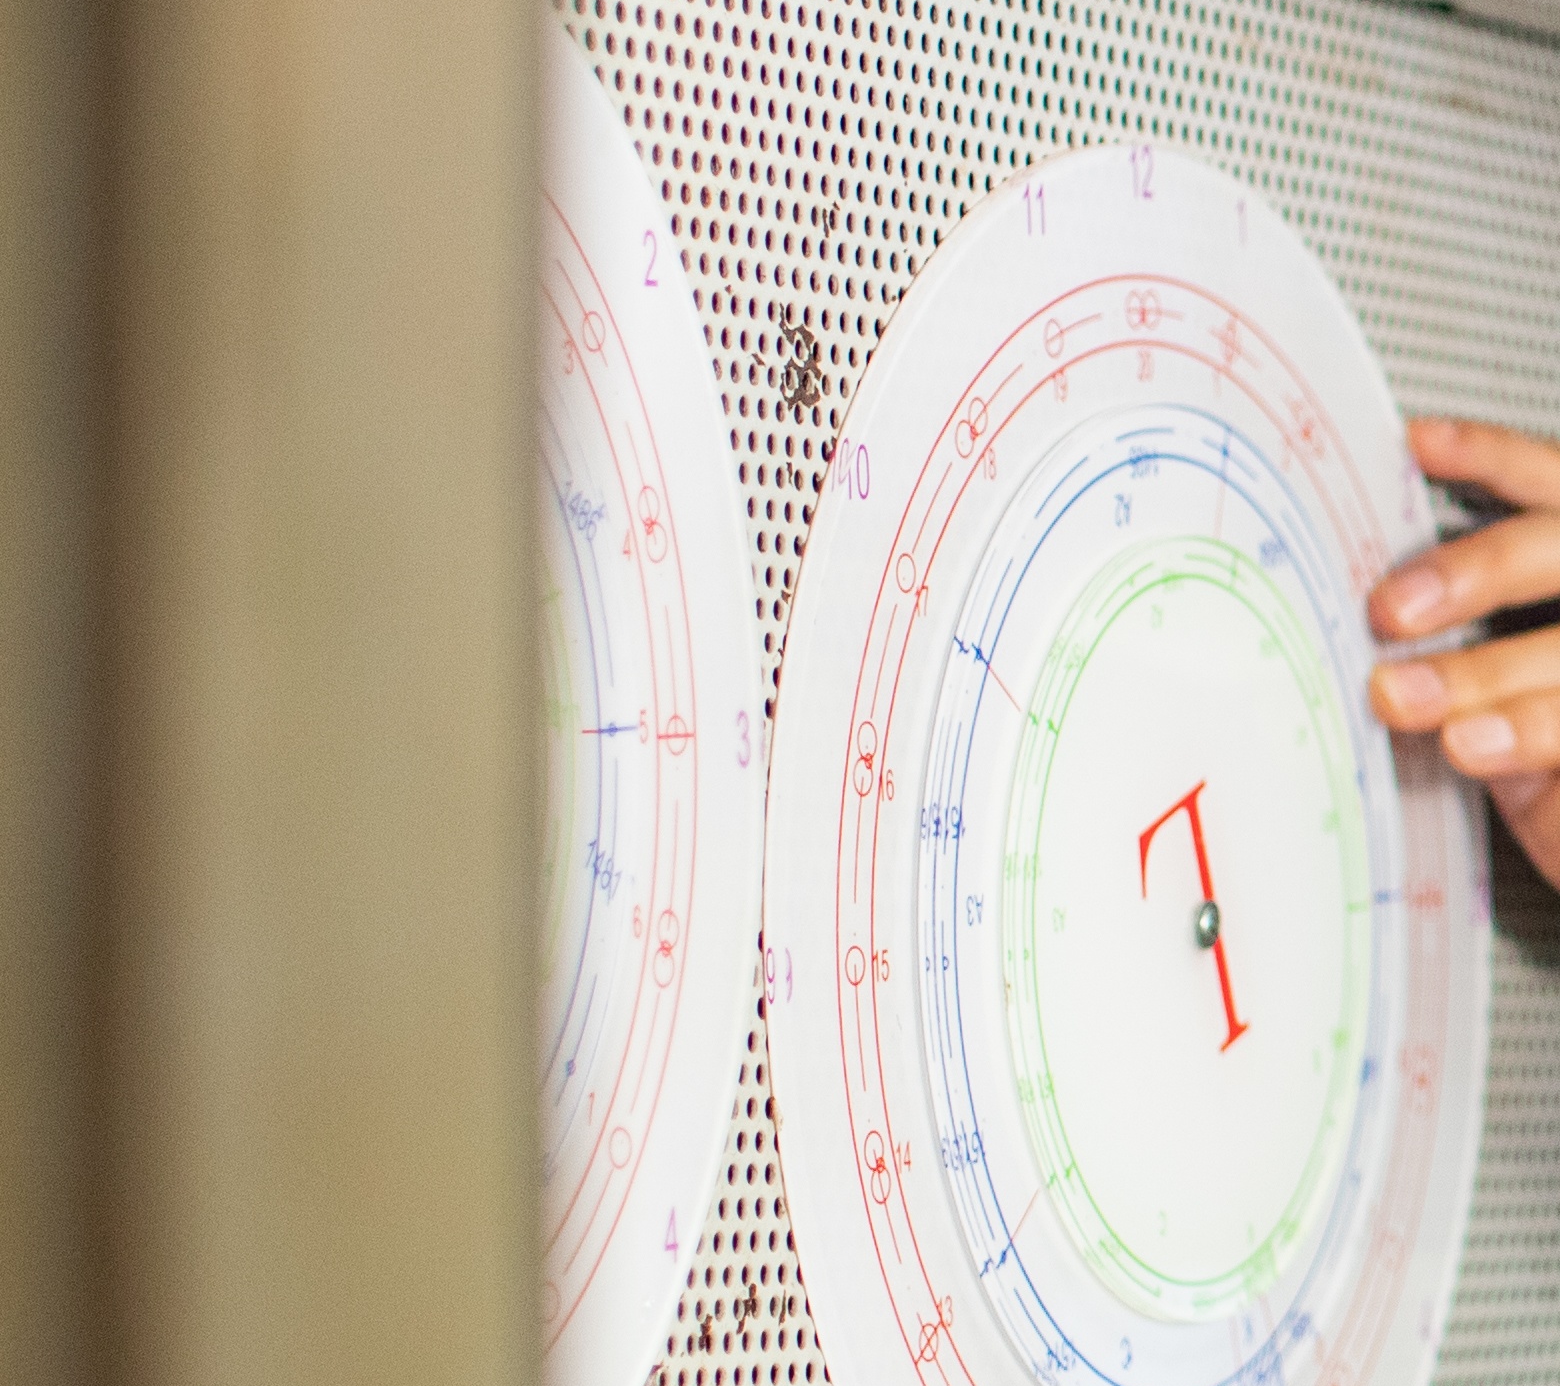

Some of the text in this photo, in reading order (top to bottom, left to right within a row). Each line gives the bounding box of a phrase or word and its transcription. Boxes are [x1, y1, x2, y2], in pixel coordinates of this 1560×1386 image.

[1131, 145, 1154, 199] 12
[1023, 183, 1046, 236] 11
[645, 230, 659, 286] 2
[736, 710, 752, 769] 3
[878, 768, 896, 801] 16
[766, 947, 777, 1004] 9
[872, 948, 890, 982] 15
[895, 1140, 912, 1174] 14
[664, 1206, 679, 1264] 4
